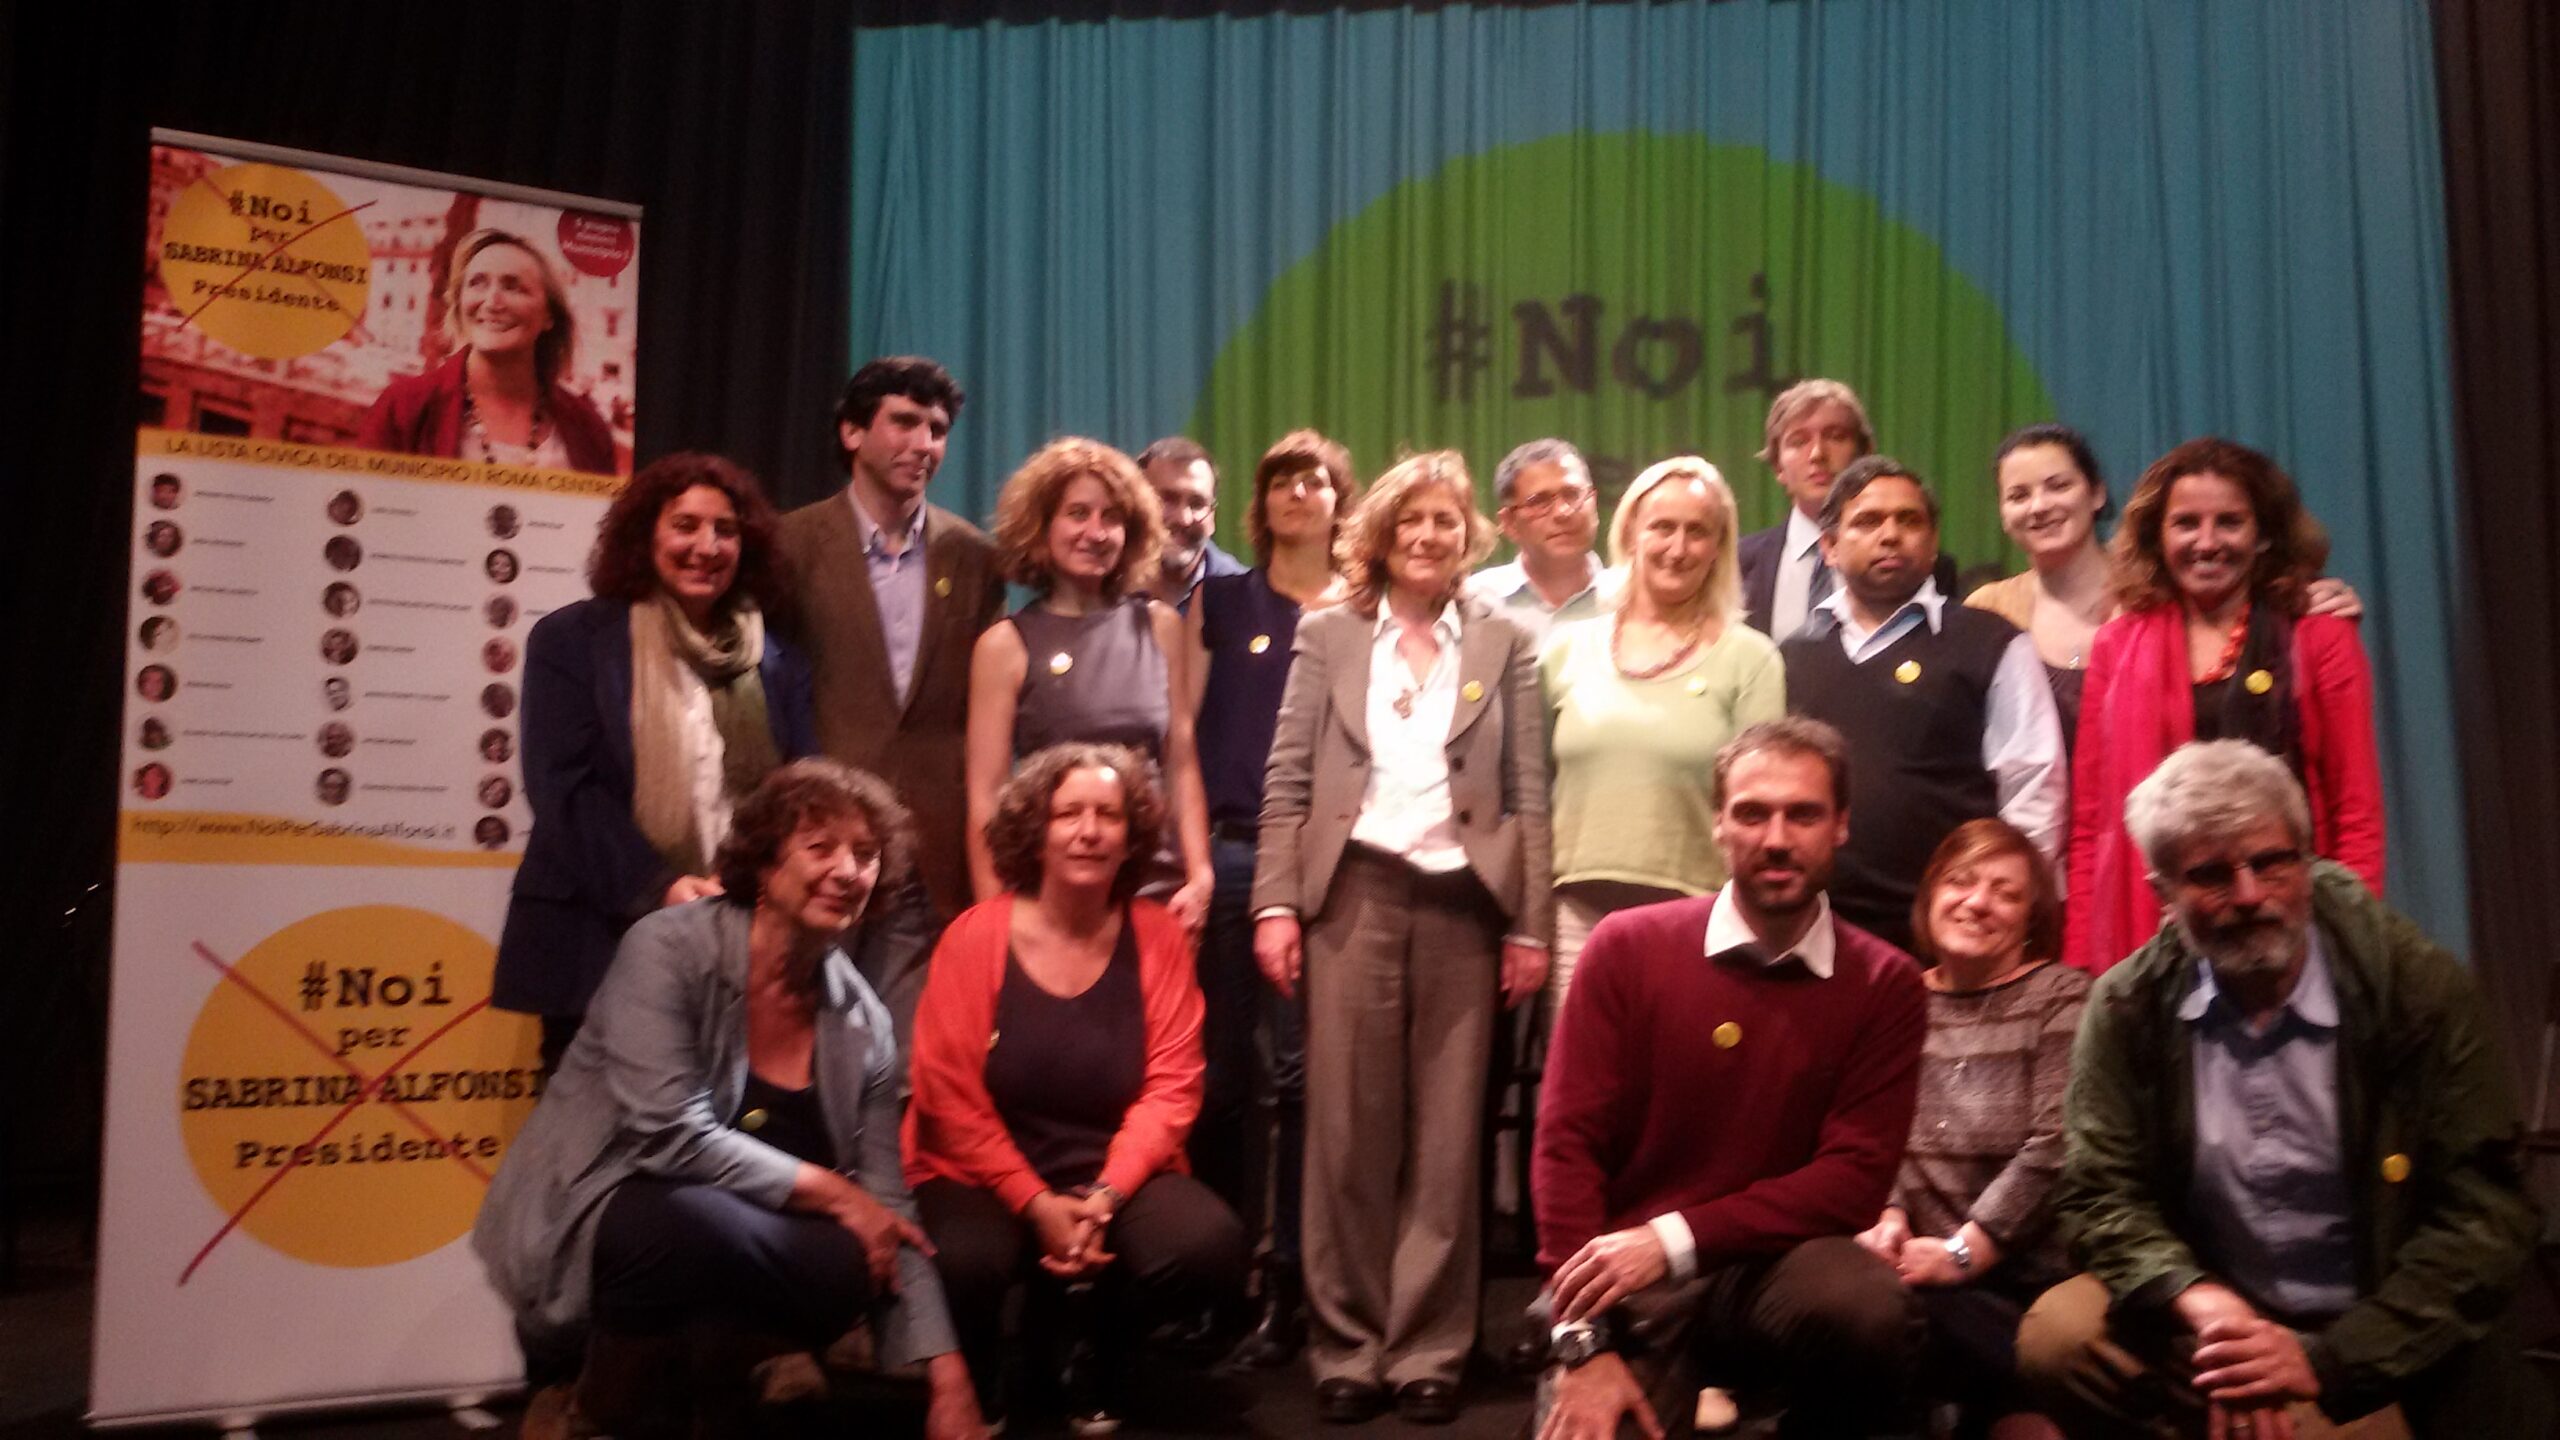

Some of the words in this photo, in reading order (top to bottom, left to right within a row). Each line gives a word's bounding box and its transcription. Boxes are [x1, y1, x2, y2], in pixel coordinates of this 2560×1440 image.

[228, 189, 315, 225] #Noi
[250, 226, 292, 244] per
[164, 241, 266, 271] SABRINA
[271, 254, 368, 285] ALFONSI
[192, 278, 340, 311] Presidente
[1424, 271, 1796, 404] #Noi
[167, 438, 191, 454] LA
[198, 440, 248, 459] LISTA
[255, 445, 320, 467] CIVICA
[327, 452, 366, 470] DEL
[368, 455, 472, 482] MUNICIPIO
[486, 469, 542, 488] ROMA
[299, 960, 452, 1011] #Noi
[336, 1023, 411, 1057] per
[182, 1073, 365, 1111] SABRINA
[376, 1067, 547, 1105] ALFONSI
[234, 1131, 500, 1169] Presidente
